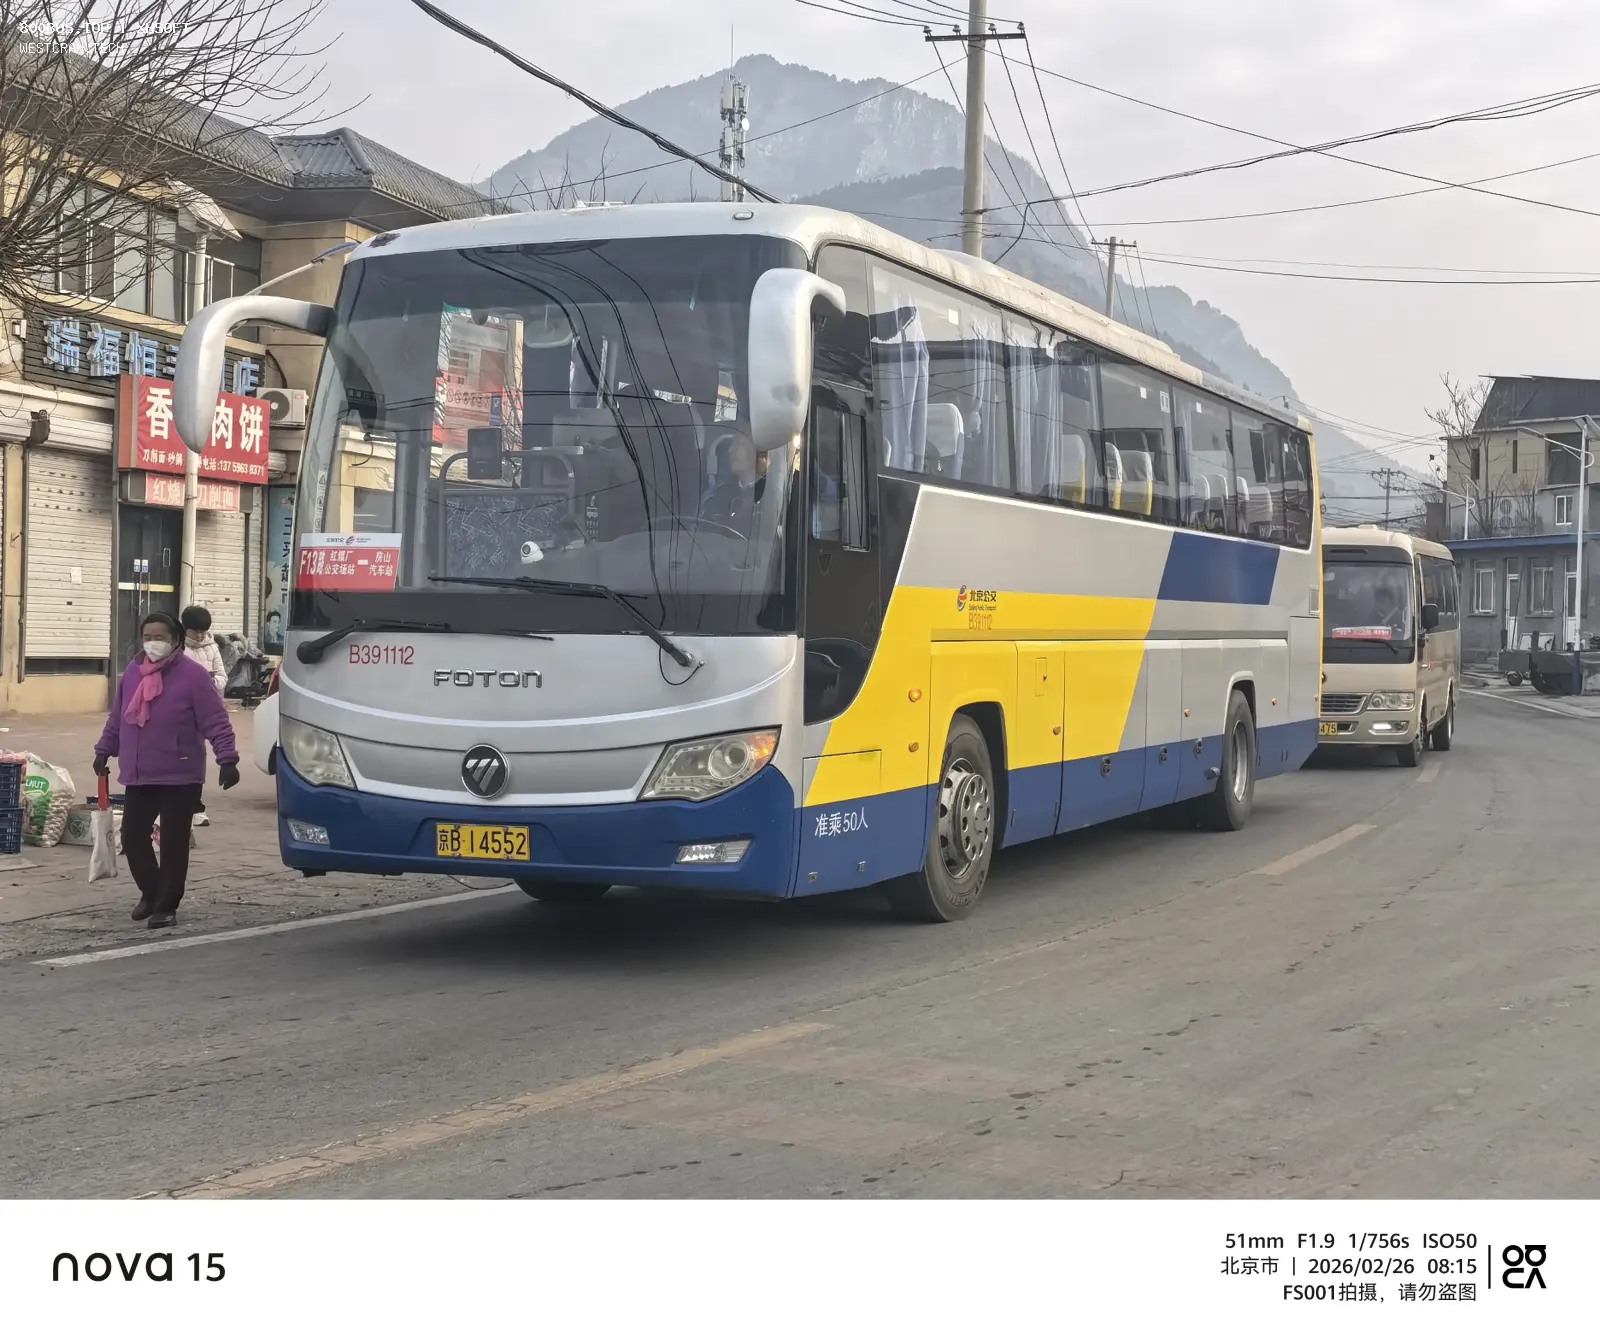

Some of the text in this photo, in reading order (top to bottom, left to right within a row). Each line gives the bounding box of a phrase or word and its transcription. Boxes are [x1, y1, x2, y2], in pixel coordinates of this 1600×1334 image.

[145, 386, 264, 454] 香肉饼
[152, 477, 234, 507] 红烧刀削面
[349, 644, 415, 665] B391112
[433, 668, 543, 688] FOTON
[814, 806, 869, 838] 准乘50人
